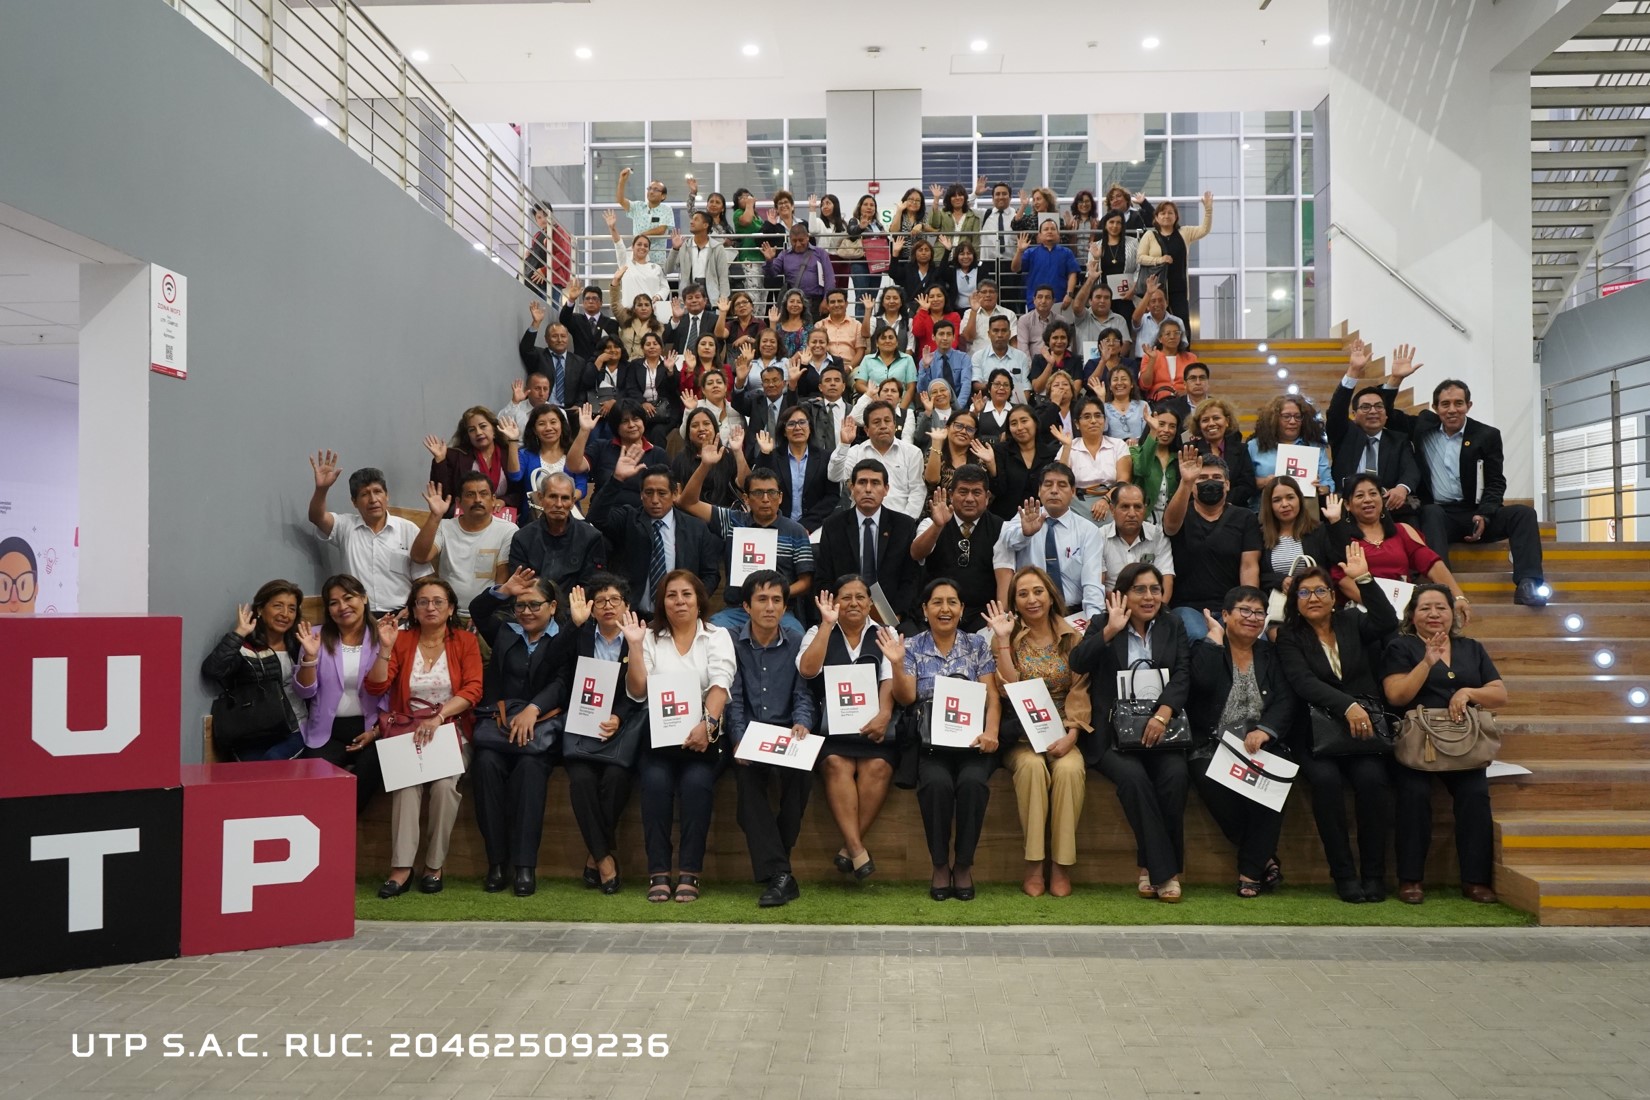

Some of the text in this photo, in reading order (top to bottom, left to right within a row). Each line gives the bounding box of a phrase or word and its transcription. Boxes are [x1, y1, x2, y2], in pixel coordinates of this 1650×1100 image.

[882, 210, 892, 223] S
[31, 655, 140, 757] U
[30, 814, 321, 933] T P
